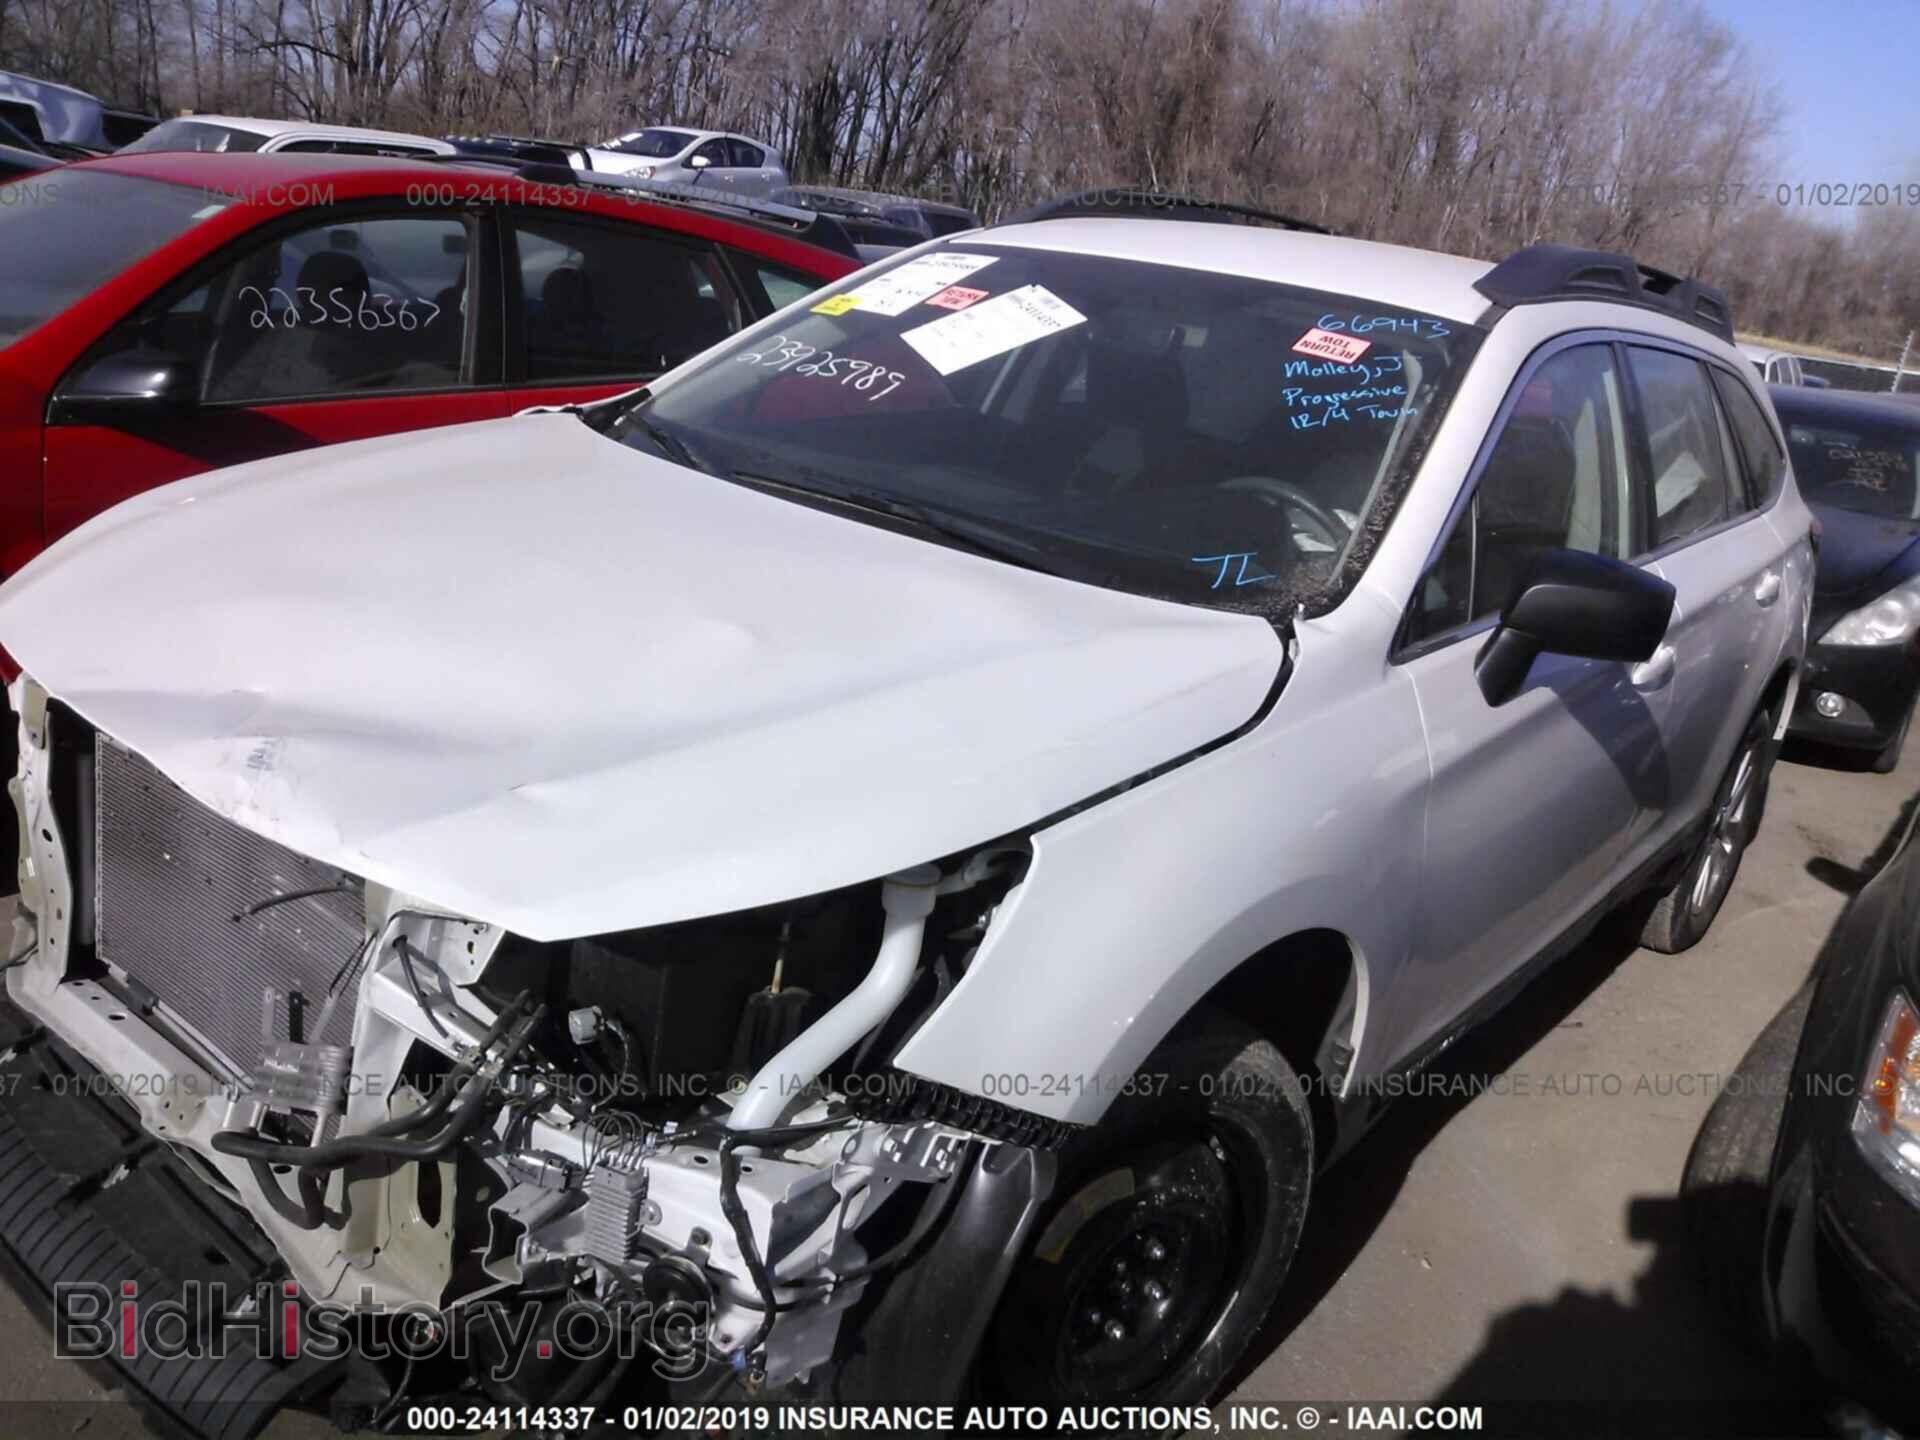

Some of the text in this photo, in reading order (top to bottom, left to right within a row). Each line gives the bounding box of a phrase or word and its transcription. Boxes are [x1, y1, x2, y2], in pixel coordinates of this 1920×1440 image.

[1318, 314, 1450, 339] 66943
[1300, 339, 1356, 360] RETURN
[1318, 335, 1352, 349] TOW
